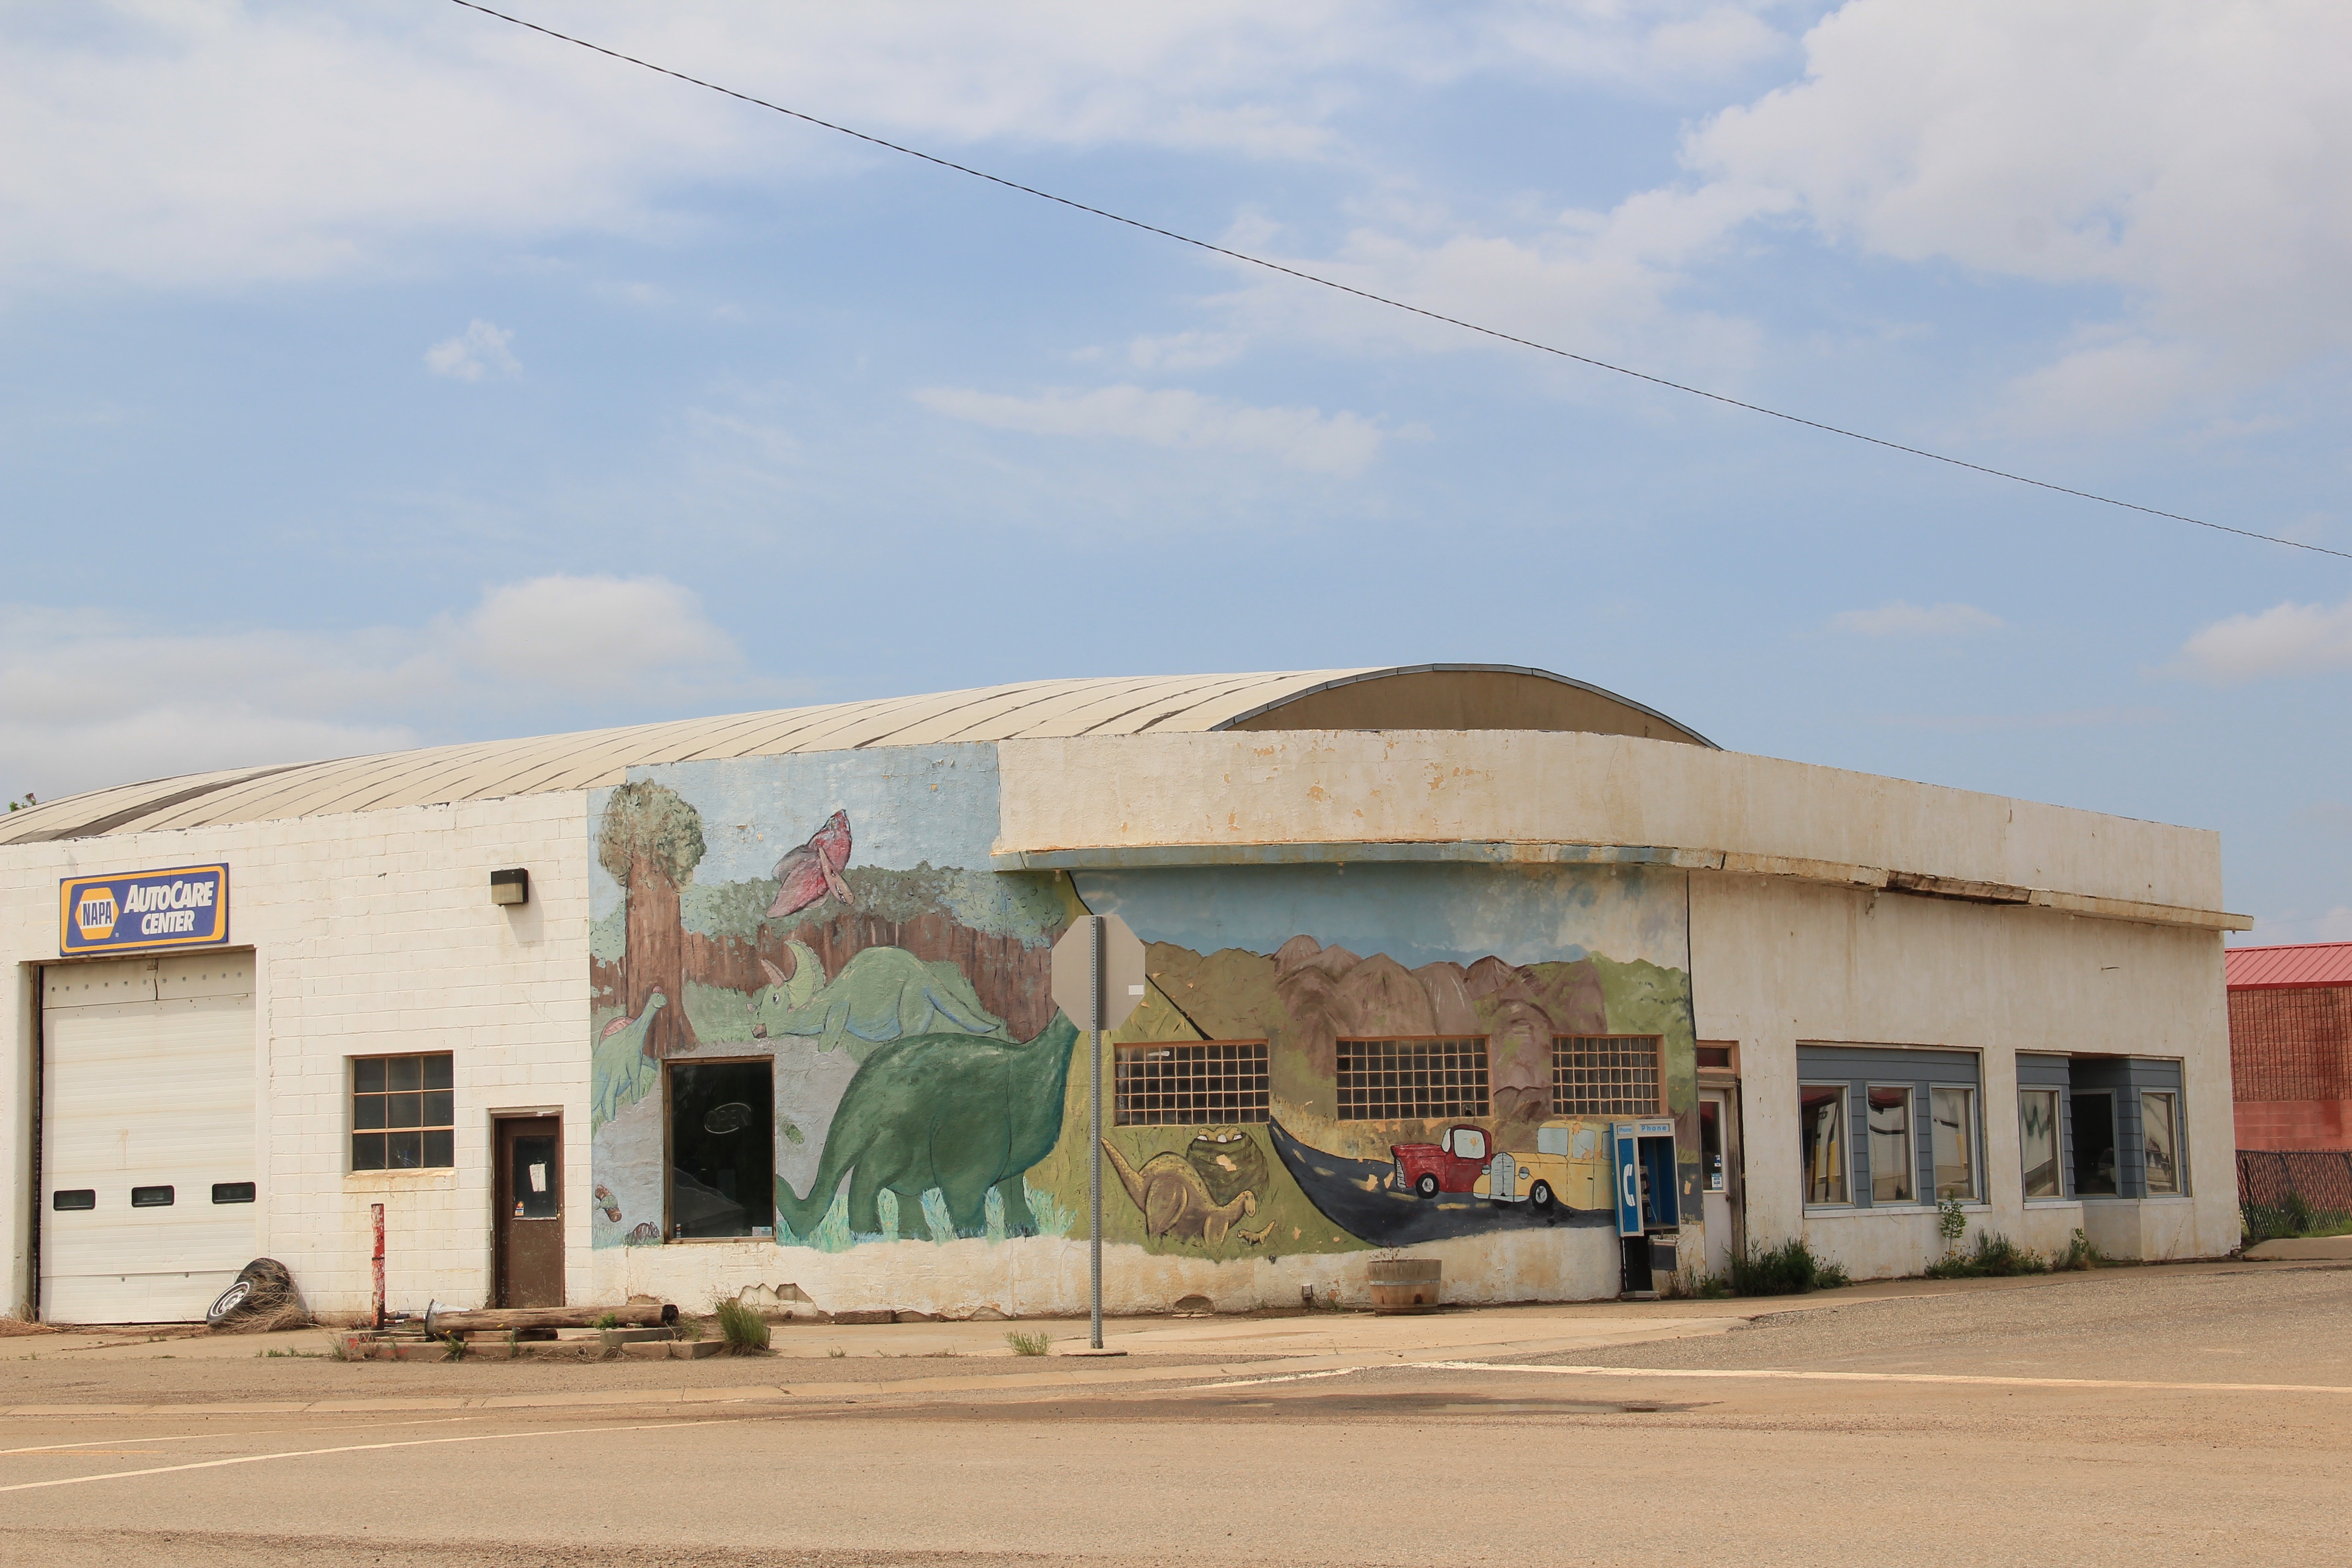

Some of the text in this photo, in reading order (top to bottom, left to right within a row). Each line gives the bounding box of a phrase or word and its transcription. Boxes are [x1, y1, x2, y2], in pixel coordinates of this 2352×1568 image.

[83, 901, 113, 926] NAPA
[141, 910, 195, 935] CENTER
[704, 1110, 751, 1127] OPEN
